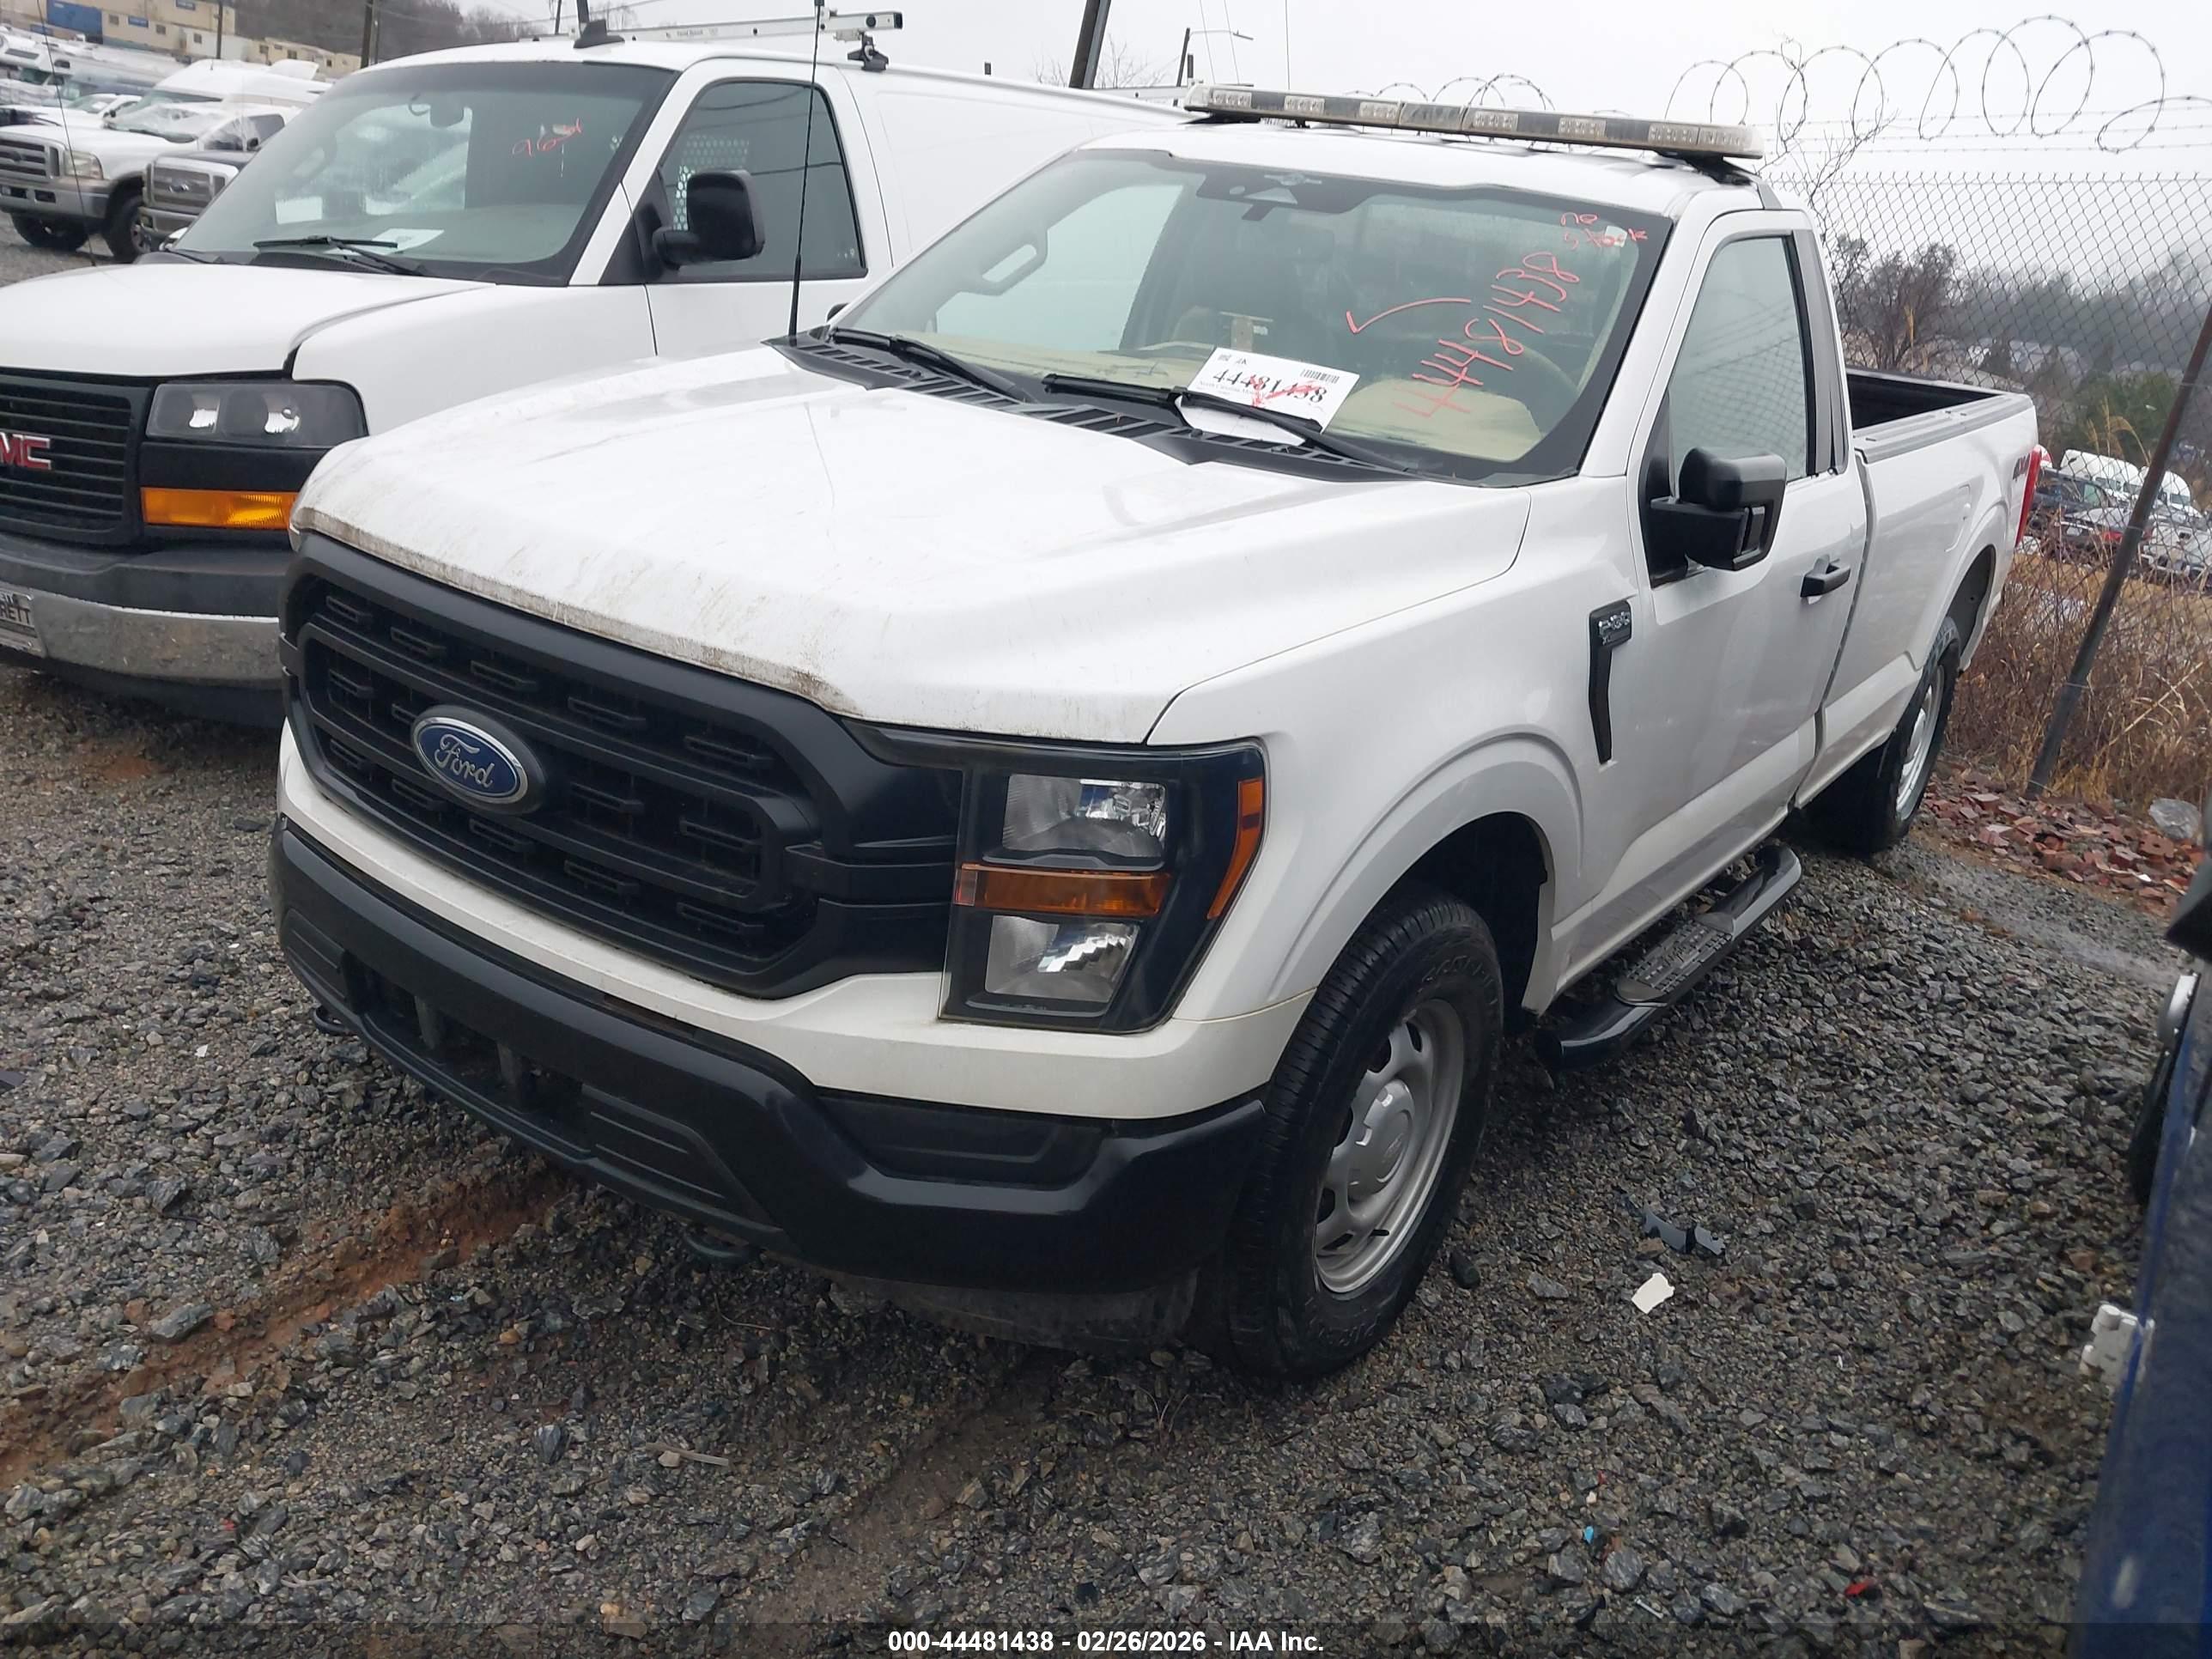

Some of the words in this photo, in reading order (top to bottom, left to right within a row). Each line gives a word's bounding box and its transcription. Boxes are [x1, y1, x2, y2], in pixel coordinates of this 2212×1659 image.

[1391, 250, 1581, 418] 44481438
[1212, 368, 1328, 404] 44481438
[434, 732, 495, 789] Ford
